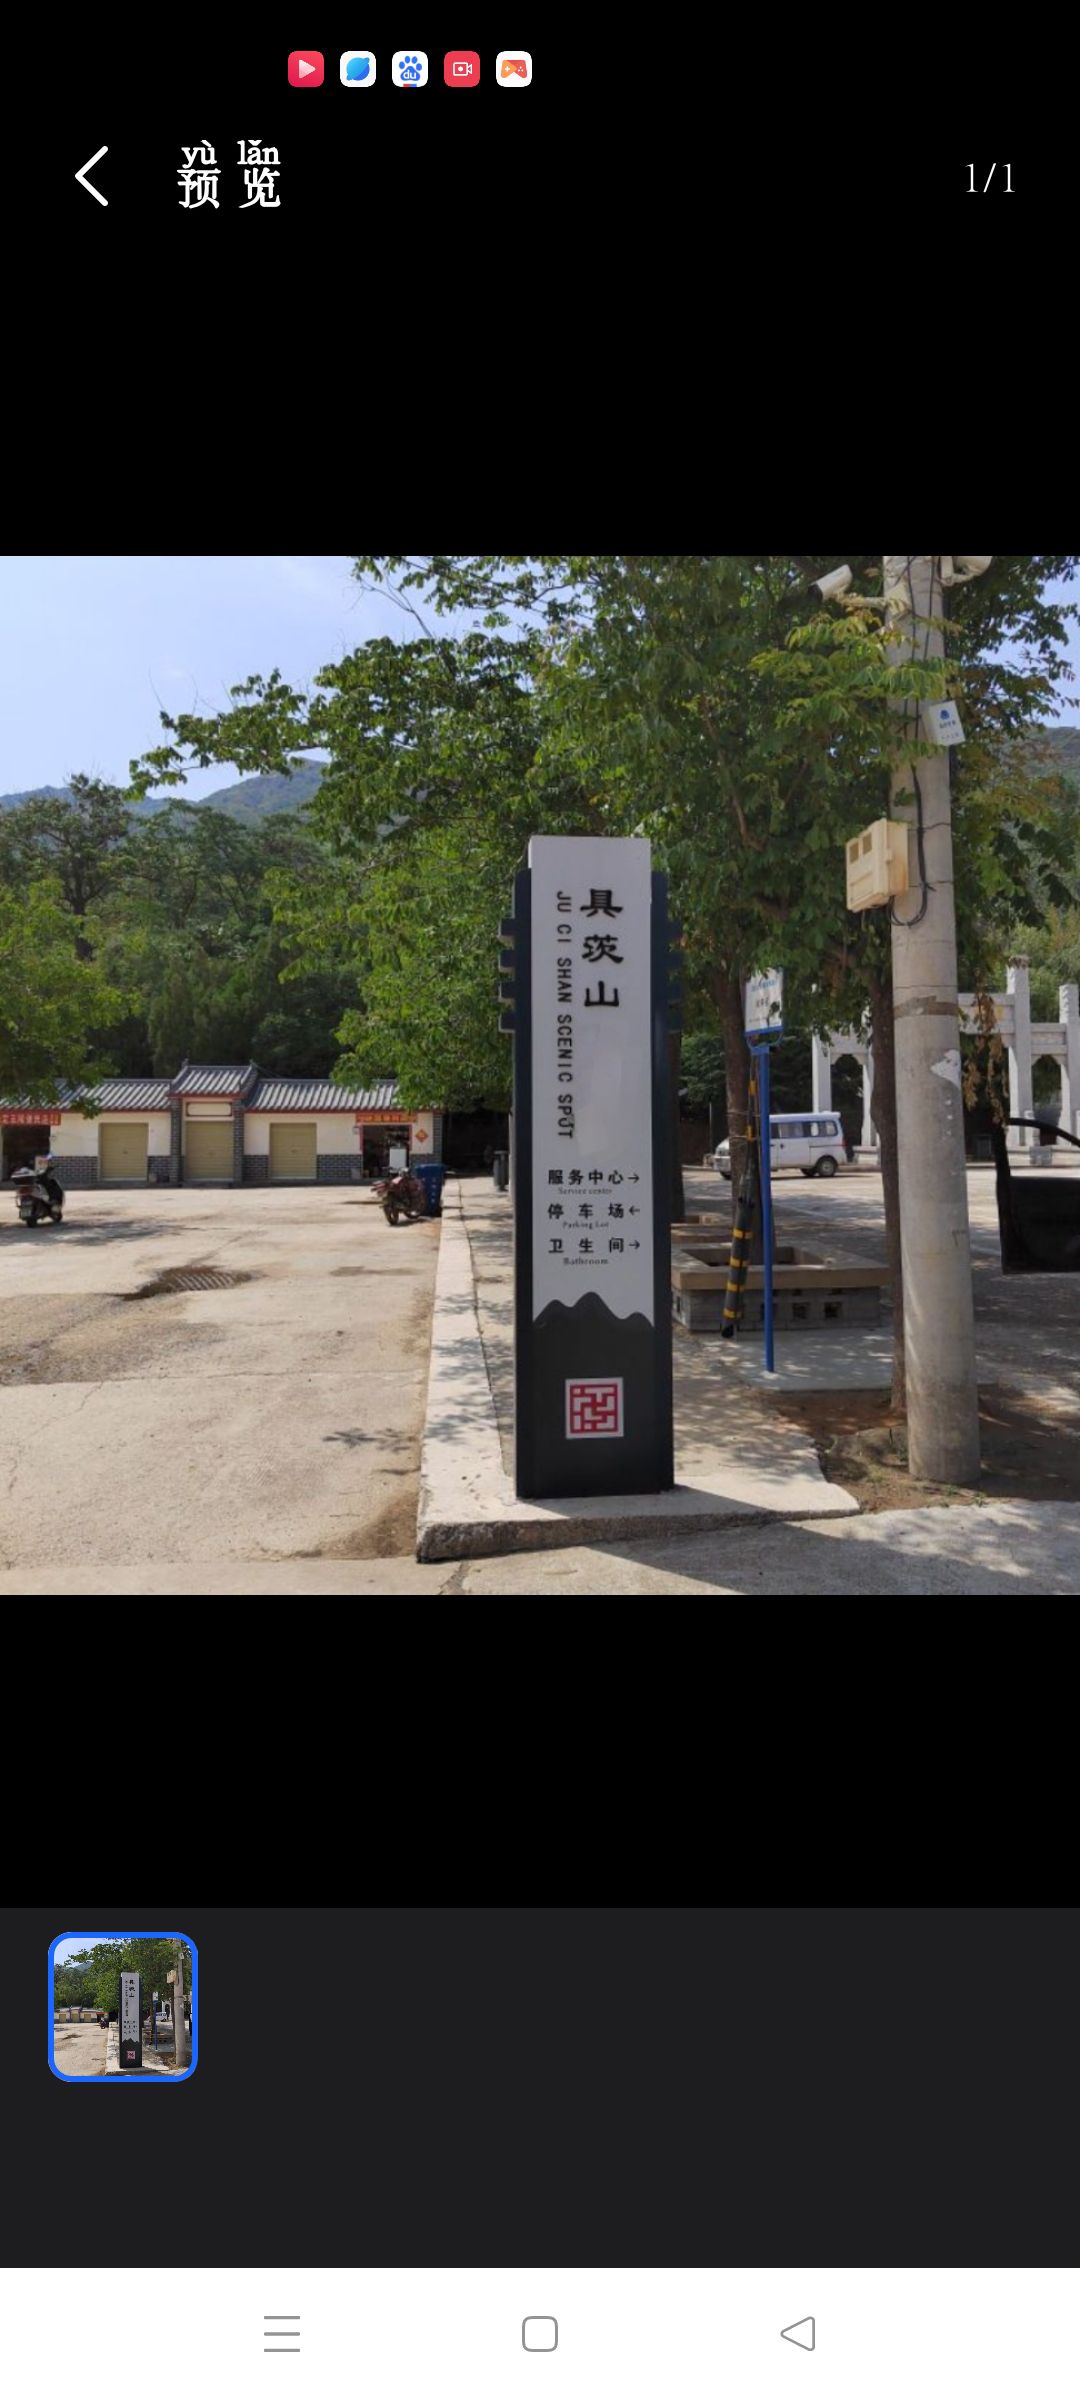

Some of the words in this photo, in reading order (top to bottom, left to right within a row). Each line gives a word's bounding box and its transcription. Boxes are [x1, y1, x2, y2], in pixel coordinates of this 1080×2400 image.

[556, 890, 572, 913] JU
[556, 923, 572, 944] CI
[580, 888, 624, 1008] 具茨山
[556, 957, 572, 1004] SHAN
[557, 1013, 574, 1083] SCENIC
[557, 1093, 574, 1139] SPOT
[548, 1168, 624, 1186] 服务中心
[547, 1203, 625, 1220] 停车场
[562, 1221, 593, 1230] Parking
[548, 1237, 625, 1254] 卫生间
[563, 1257, 609, 1266] Bathroom
